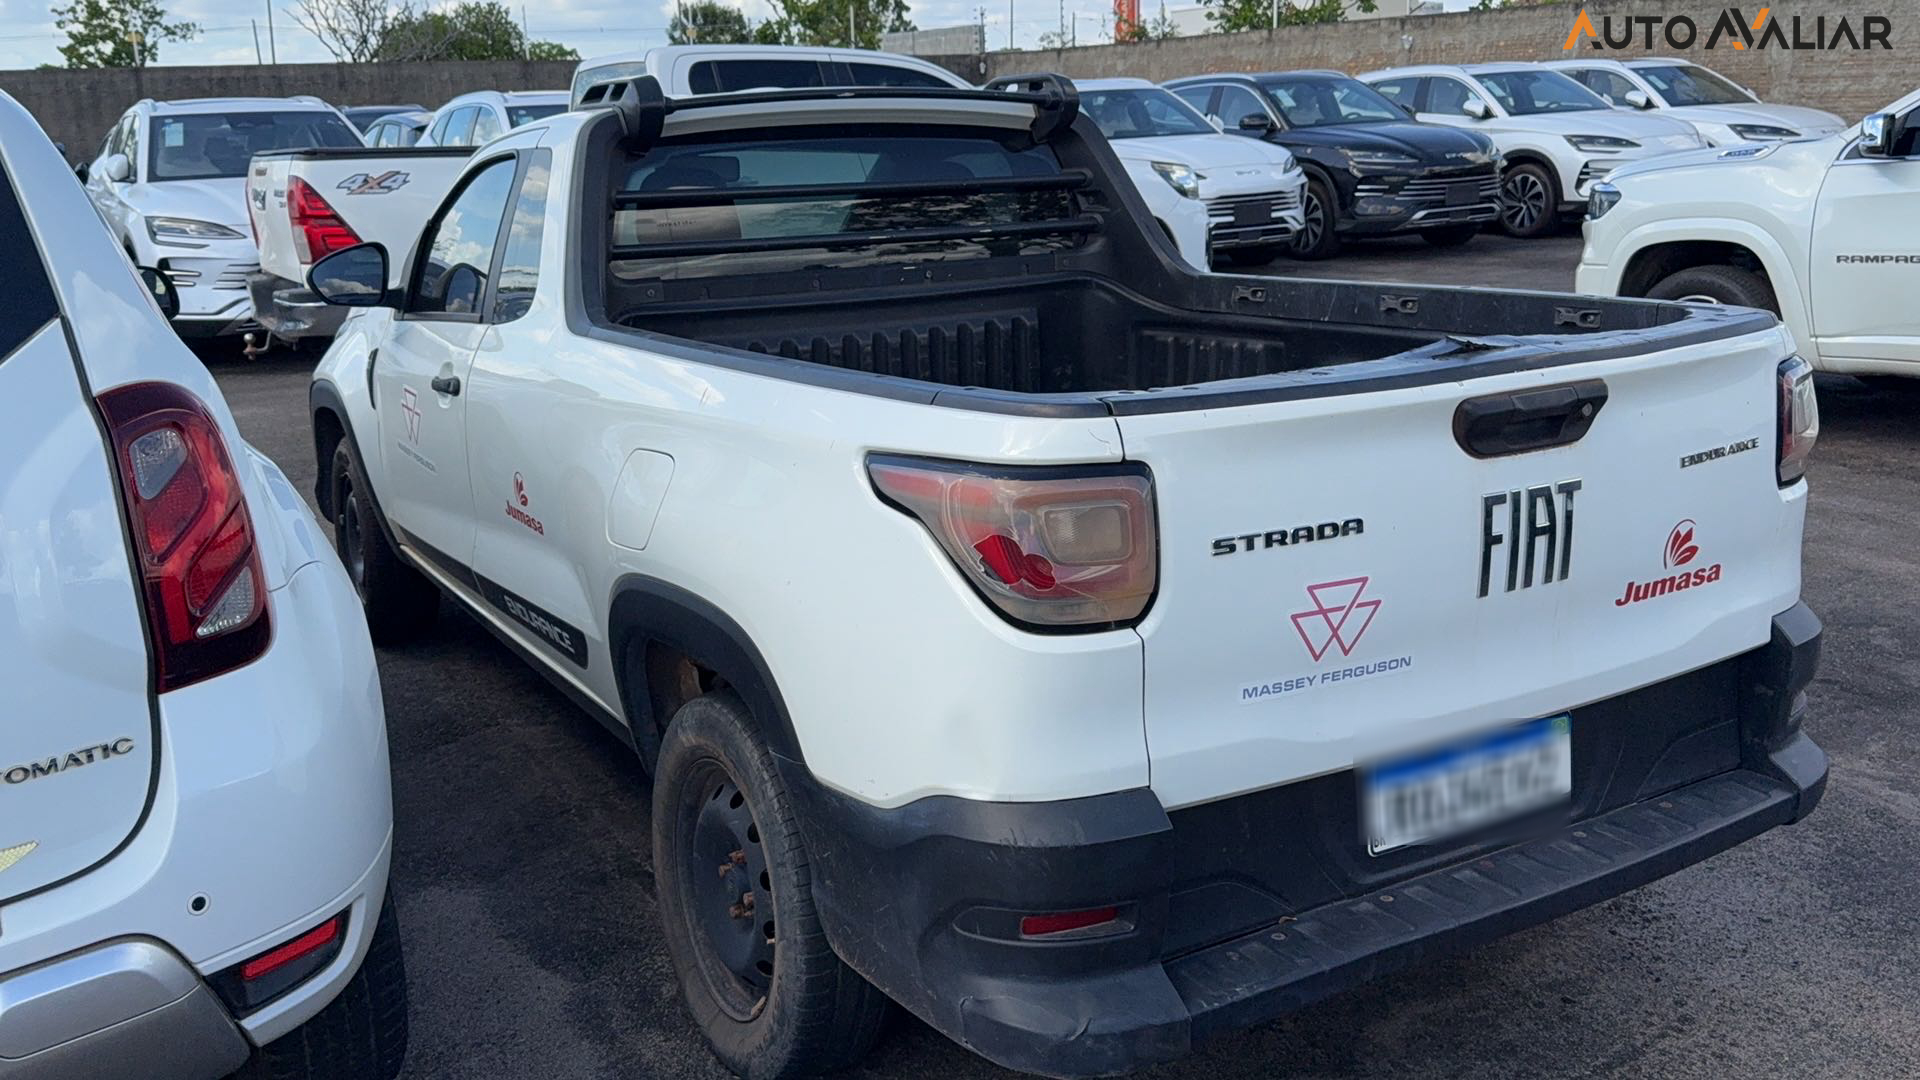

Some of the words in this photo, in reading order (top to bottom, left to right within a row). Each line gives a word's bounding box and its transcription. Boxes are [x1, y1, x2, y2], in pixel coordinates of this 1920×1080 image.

[1680, 437, 1759, 469] ENDURANCE
[504, 499, 544, 536] Jumasa
[1211, 518, 1364, 556] STRADA
[1476, 477, 1582, 598] FIAT
[1615, 563, 1721, 606] Jumasa
[1242, 675, 1317, 700] MASSEY
[1321, 656, 1412, 684] FERGUSON
